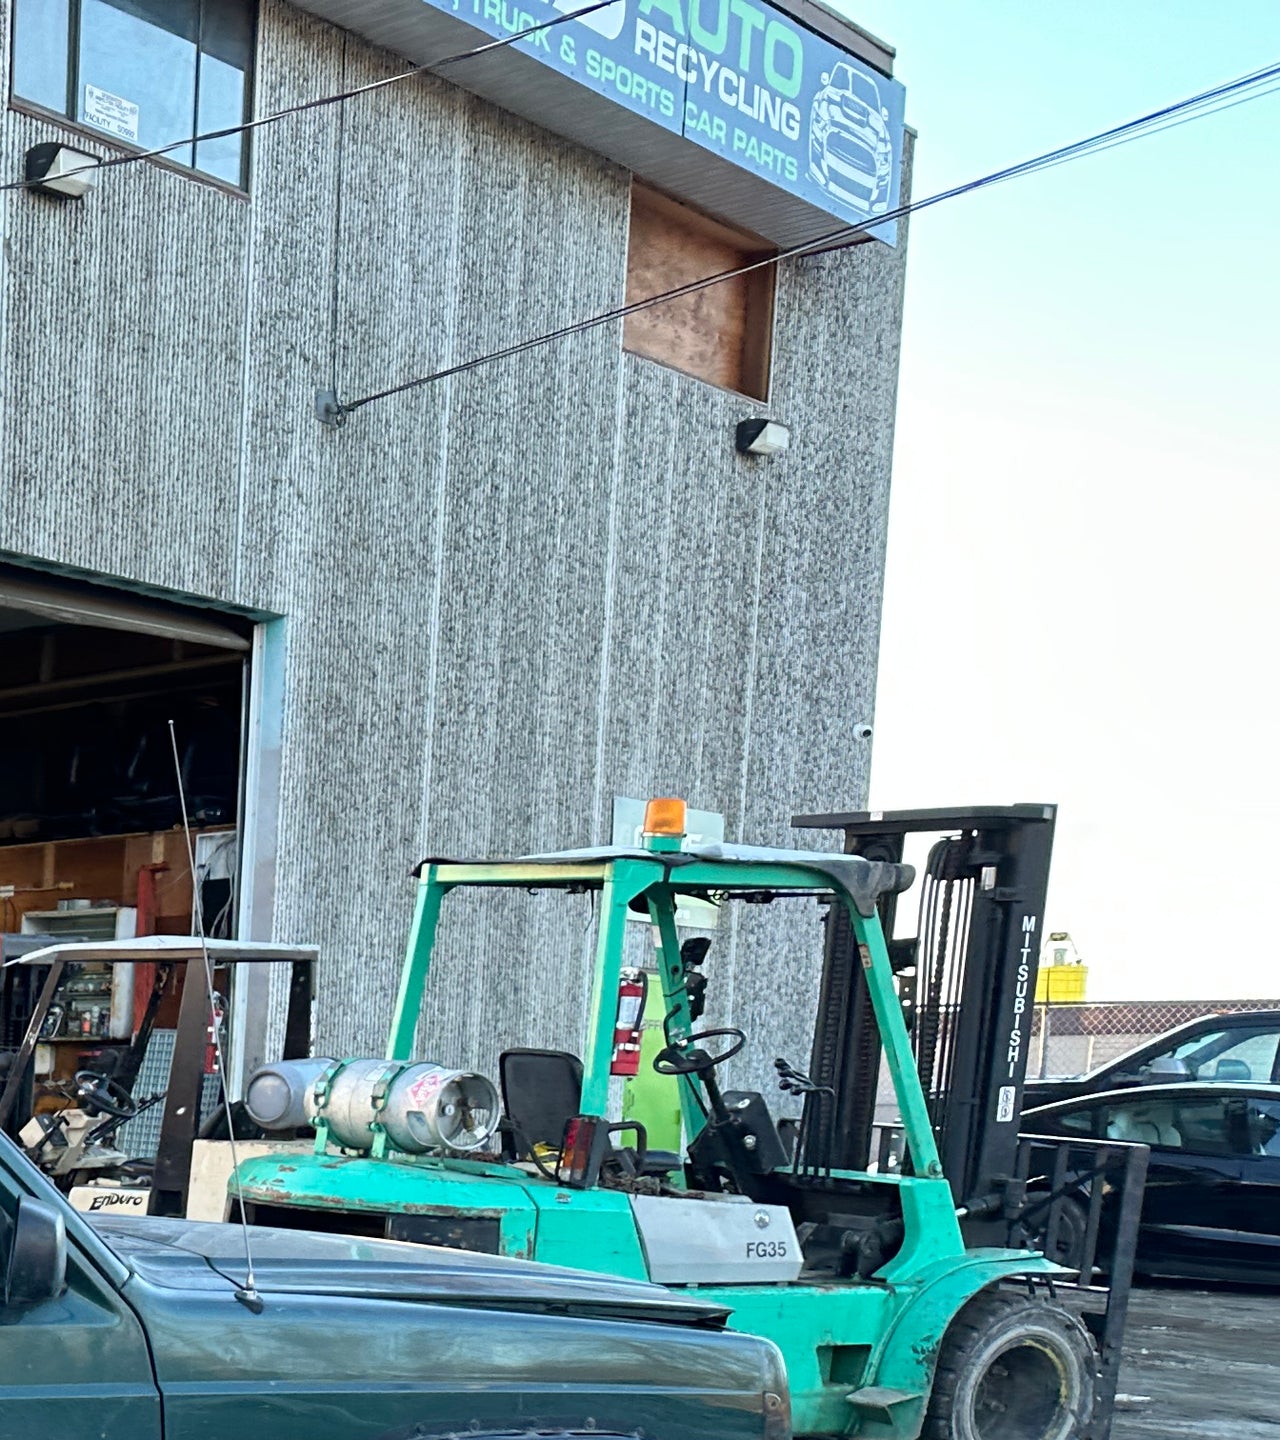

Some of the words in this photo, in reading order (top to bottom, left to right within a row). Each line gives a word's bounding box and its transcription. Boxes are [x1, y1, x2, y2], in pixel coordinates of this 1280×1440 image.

[559, 34, 577, 66] &
[585, 49, 675, 117] SPORTS
[684, 101, 727, 145] CAR
[733, 128, 798, 181] PARTS
[634, 18, 801, 141] RECYCLING
[638, 0, 803, 99] AUTO
[1008, 915, 1036, 1078] MITSUBISHI
[746, 1241, 787, 1258] FG35
